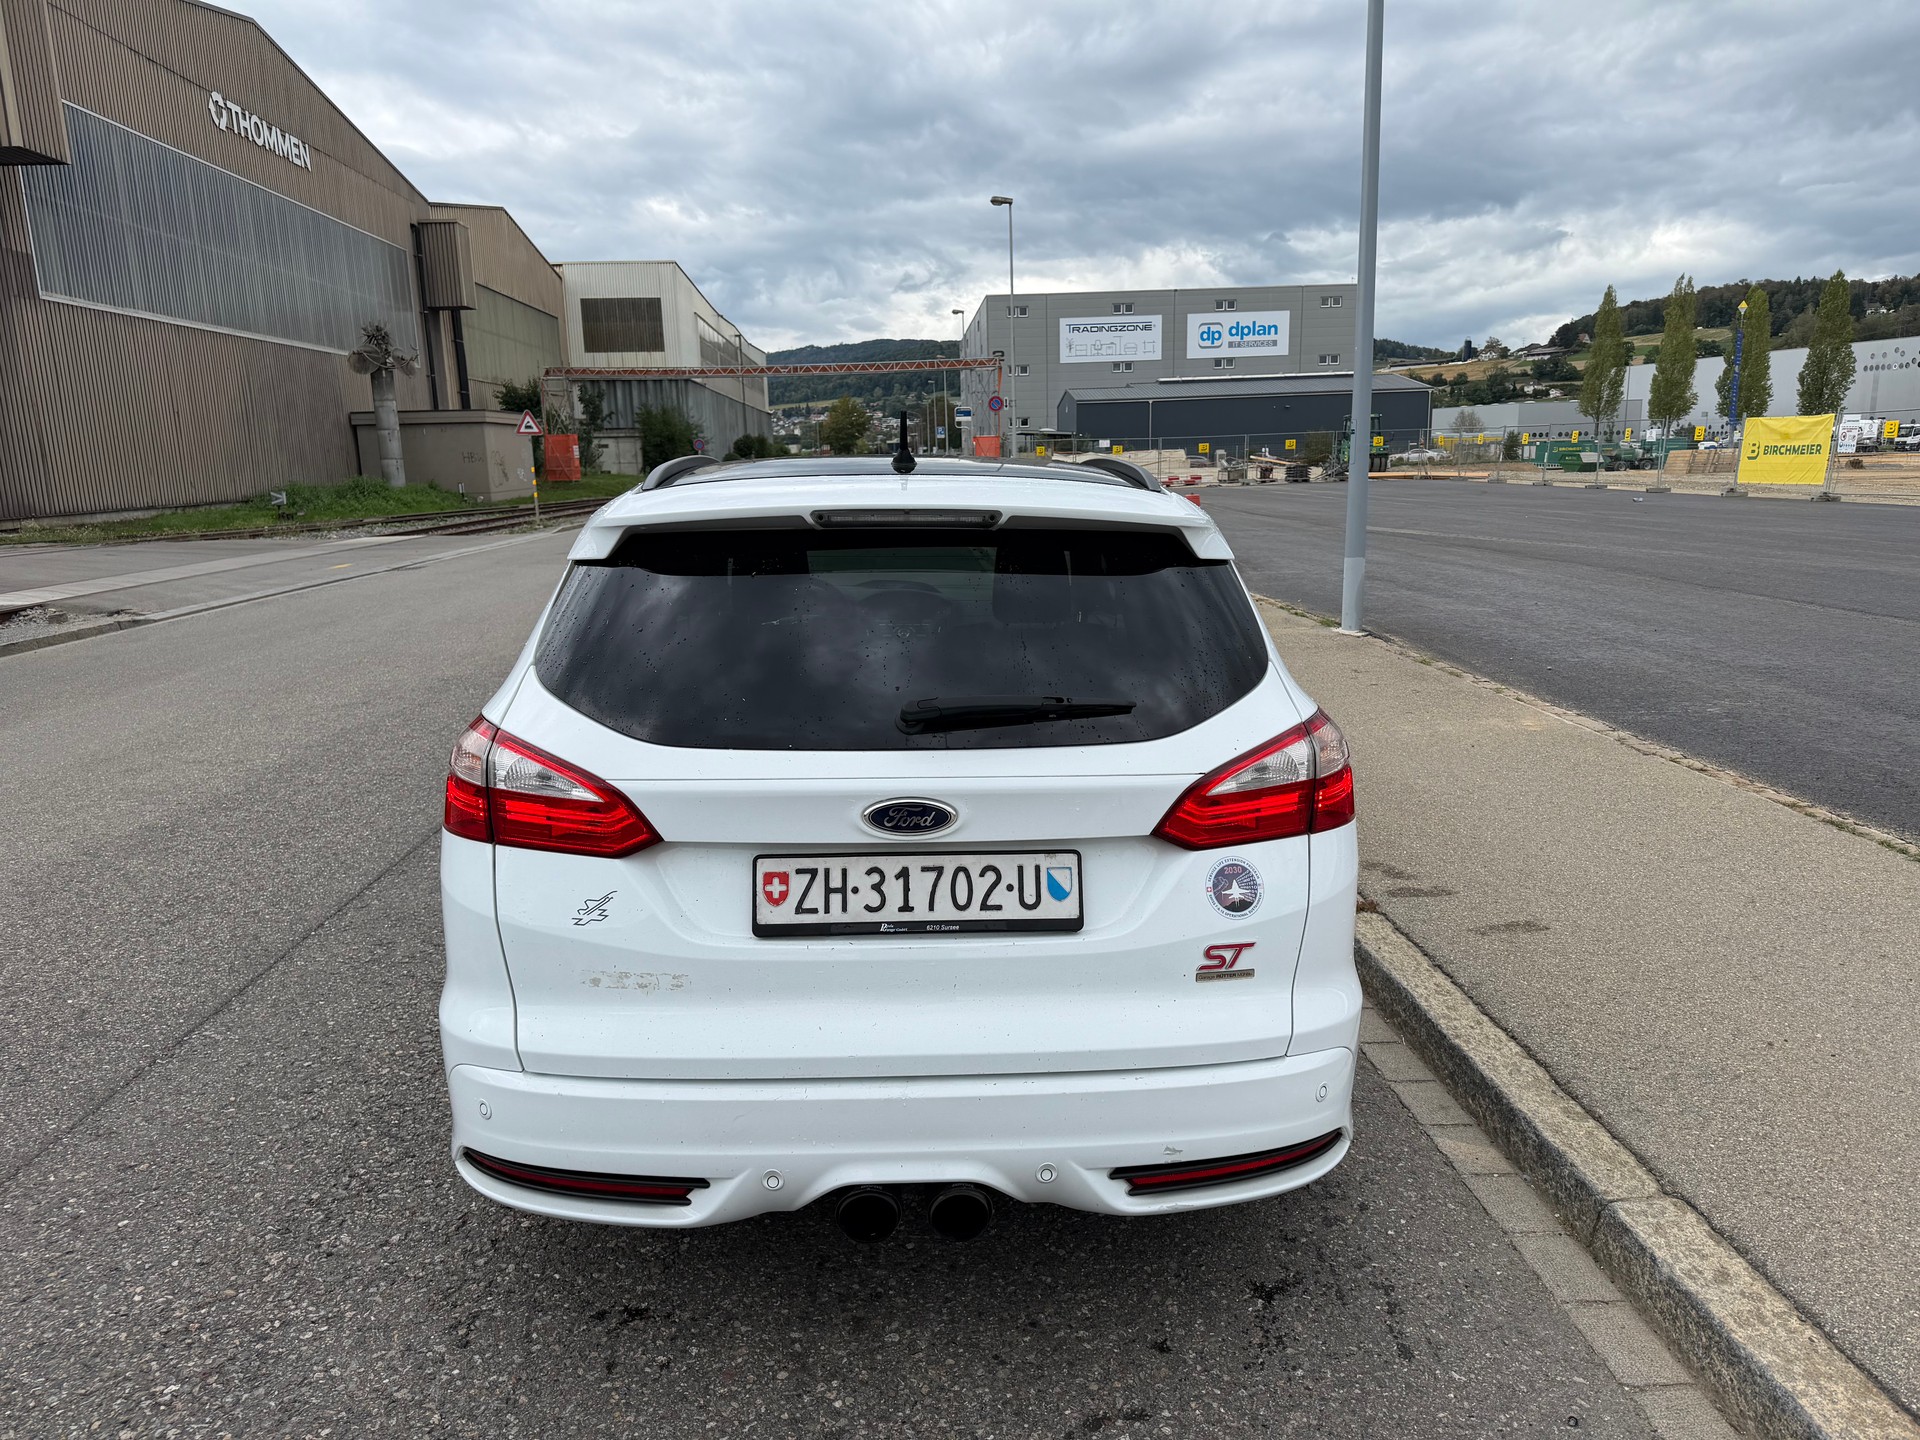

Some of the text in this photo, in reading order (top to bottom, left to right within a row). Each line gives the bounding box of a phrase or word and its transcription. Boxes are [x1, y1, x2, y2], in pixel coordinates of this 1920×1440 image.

[226, 100, 312, 172] THOMMEN
[1200, 326, 1222, 345] dp
[1228, 321, 1278, 340] dplan
[1763, 443, 1822, 456] BIRCHMEIER
[884, 807, 935, 828] Ford
[1208, 866, 1217, 882] SERVICE
[1246, 862, 1261, 879] PROGRAM
[1224, 866, 1243, 874] 2030
[1196, 942, 1257, 971] ST
